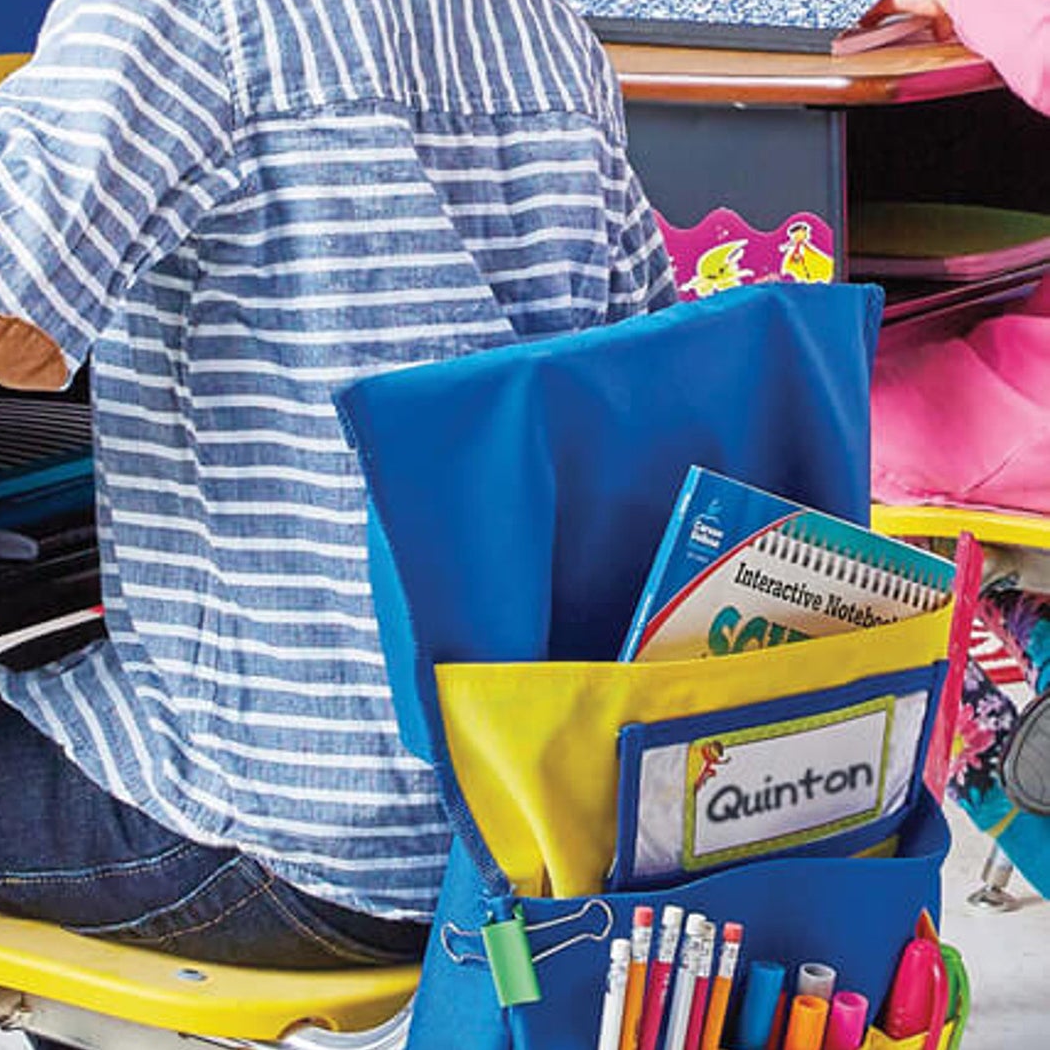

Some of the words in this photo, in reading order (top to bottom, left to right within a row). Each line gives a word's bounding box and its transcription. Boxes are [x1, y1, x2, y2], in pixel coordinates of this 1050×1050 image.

[734, 562, 824, 612] Interactive
[823, 593, 899, 629] Noteb
[706, 762, 873, 823] Quinton
